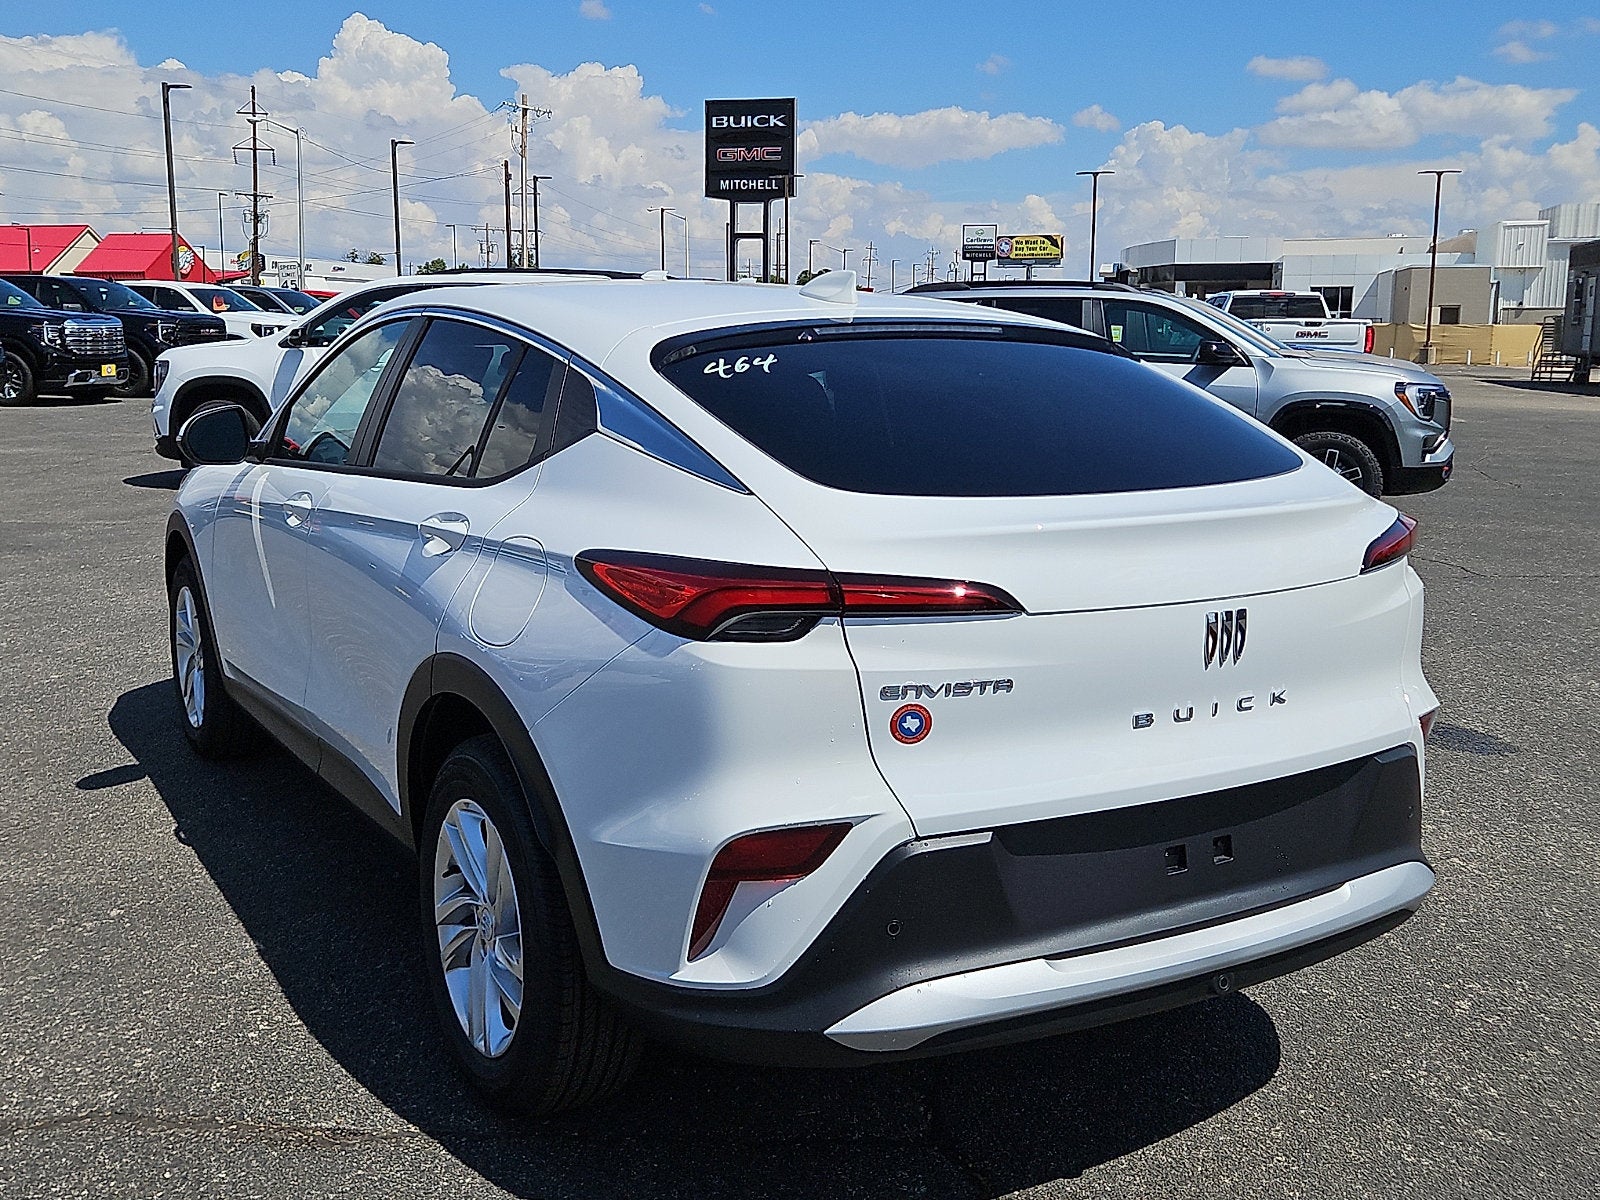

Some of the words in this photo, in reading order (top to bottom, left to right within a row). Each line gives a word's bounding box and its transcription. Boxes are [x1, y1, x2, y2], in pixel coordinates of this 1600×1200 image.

[711, 115, 787, 128] BUICK
[716, 147, 782, 161] GMC
[720, 180, 778, 190] MITCHELL
[281, 280, 297, 289] 45
[703, 353, 778, 379] 464
[879, 678, 1014, 701] ENVISTA
[1132, 688, 1287, 730] BUICK
